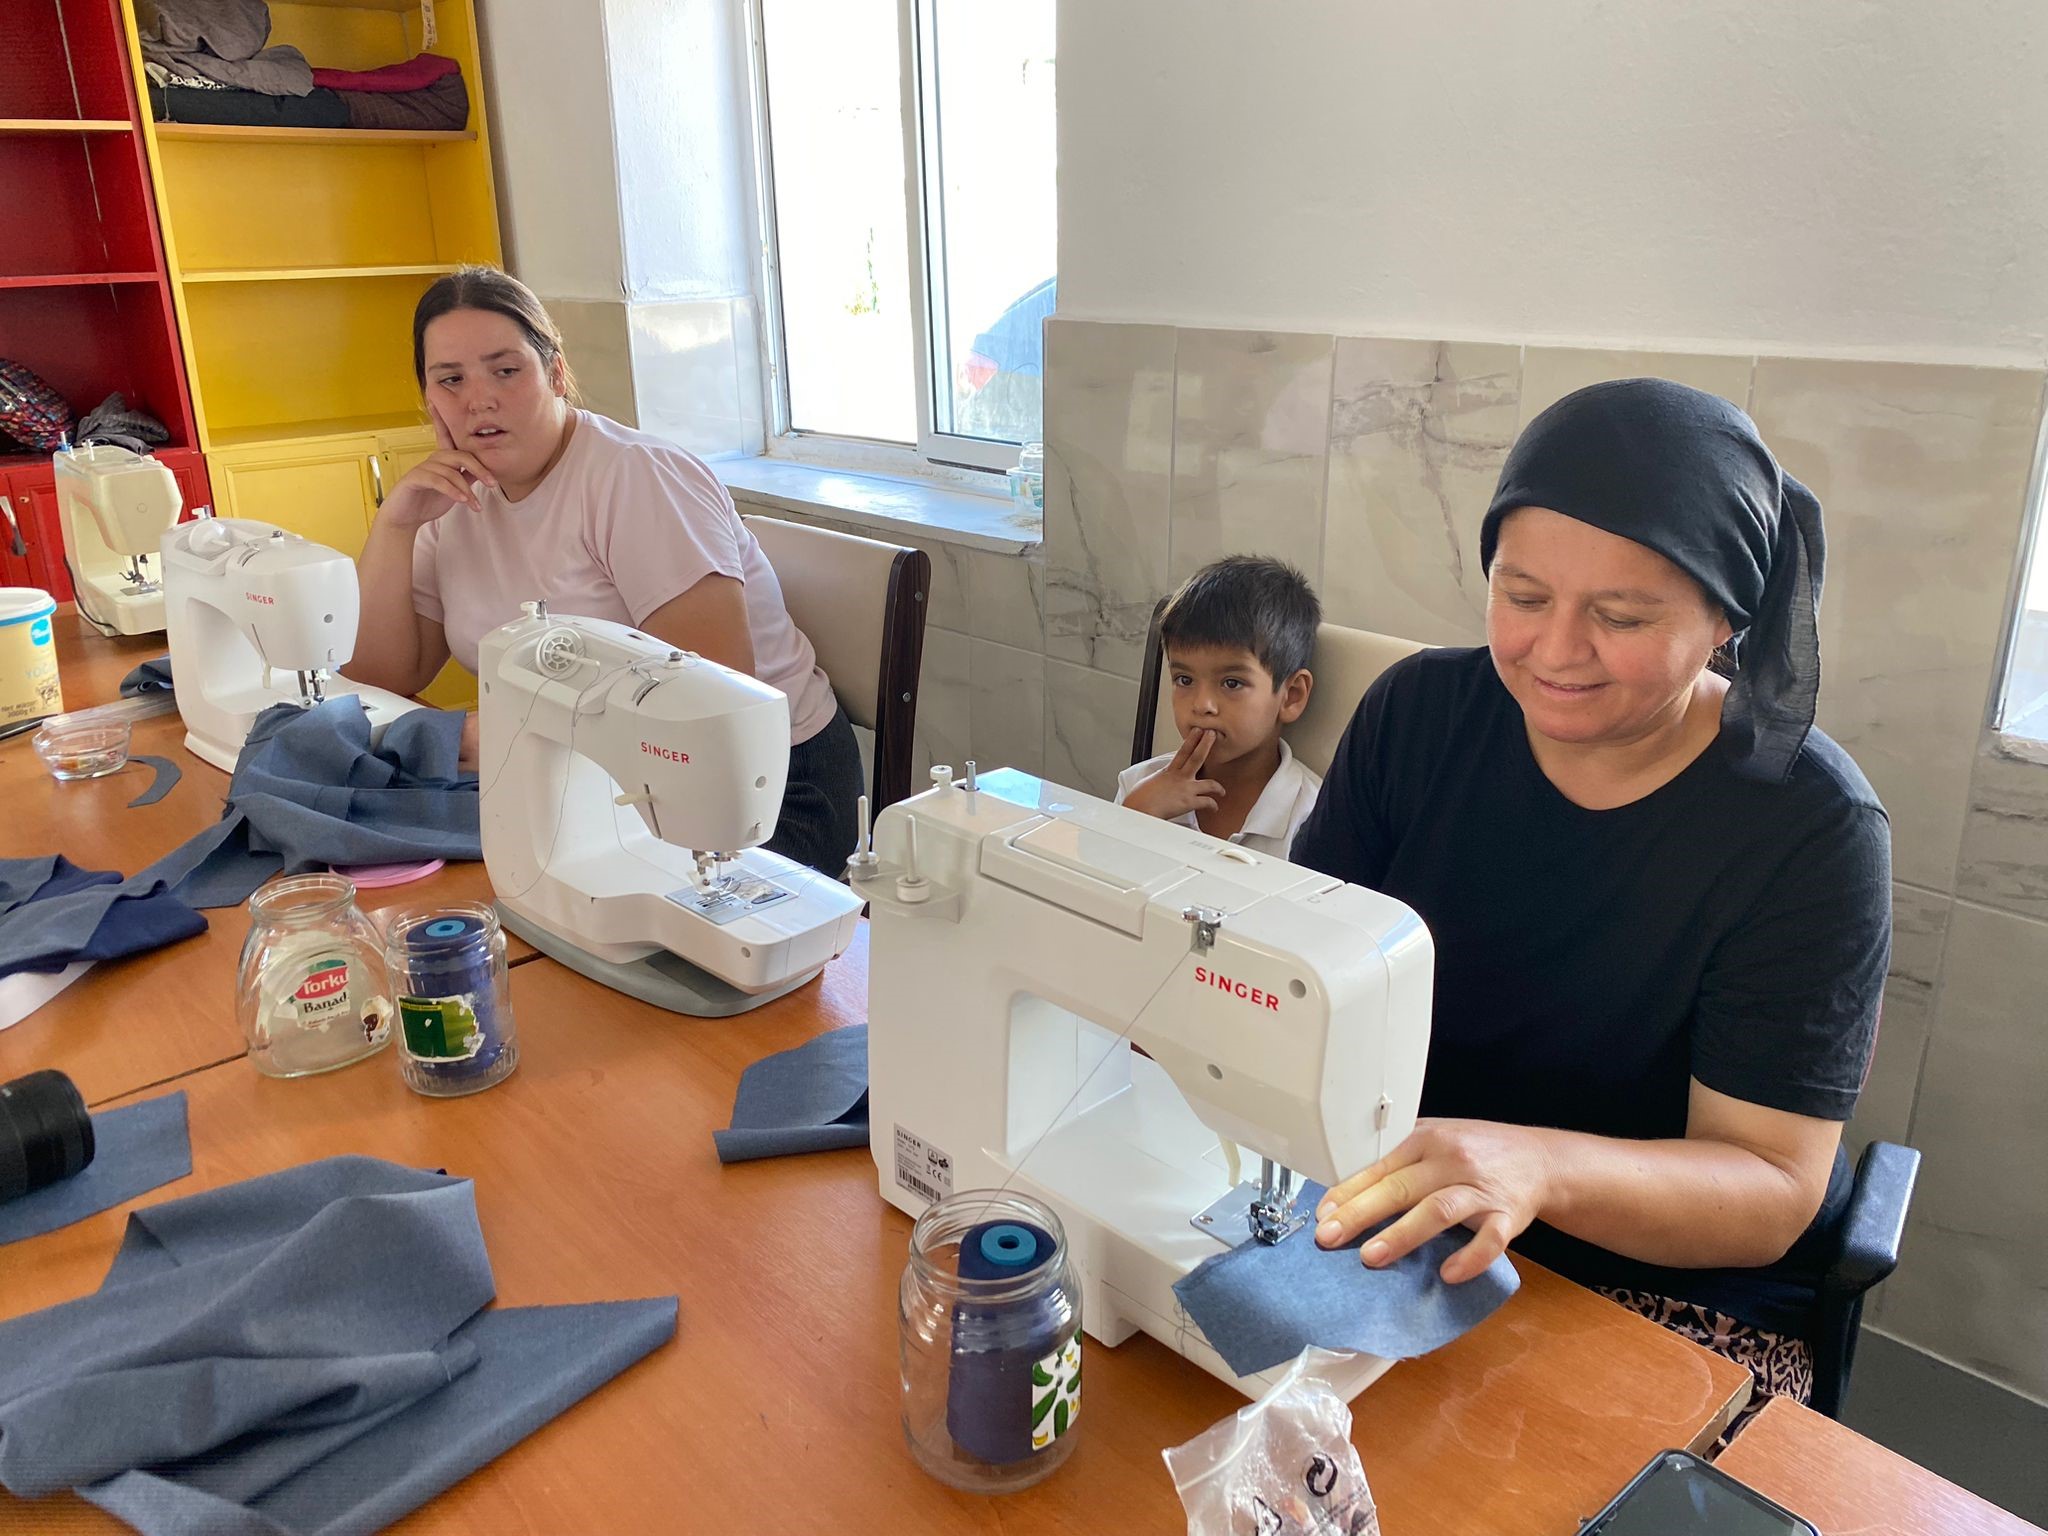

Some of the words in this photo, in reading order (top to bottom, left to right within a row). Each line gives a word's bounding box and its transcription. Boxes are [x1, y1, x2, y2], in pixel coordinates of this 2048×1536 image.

[245, 592, 275, 605] SINGER
[640, 741, 690, 764] SINGER
[1195, 966, 1280, 1011] SINGER
[896, 1129, 921, 1149] SINGER
